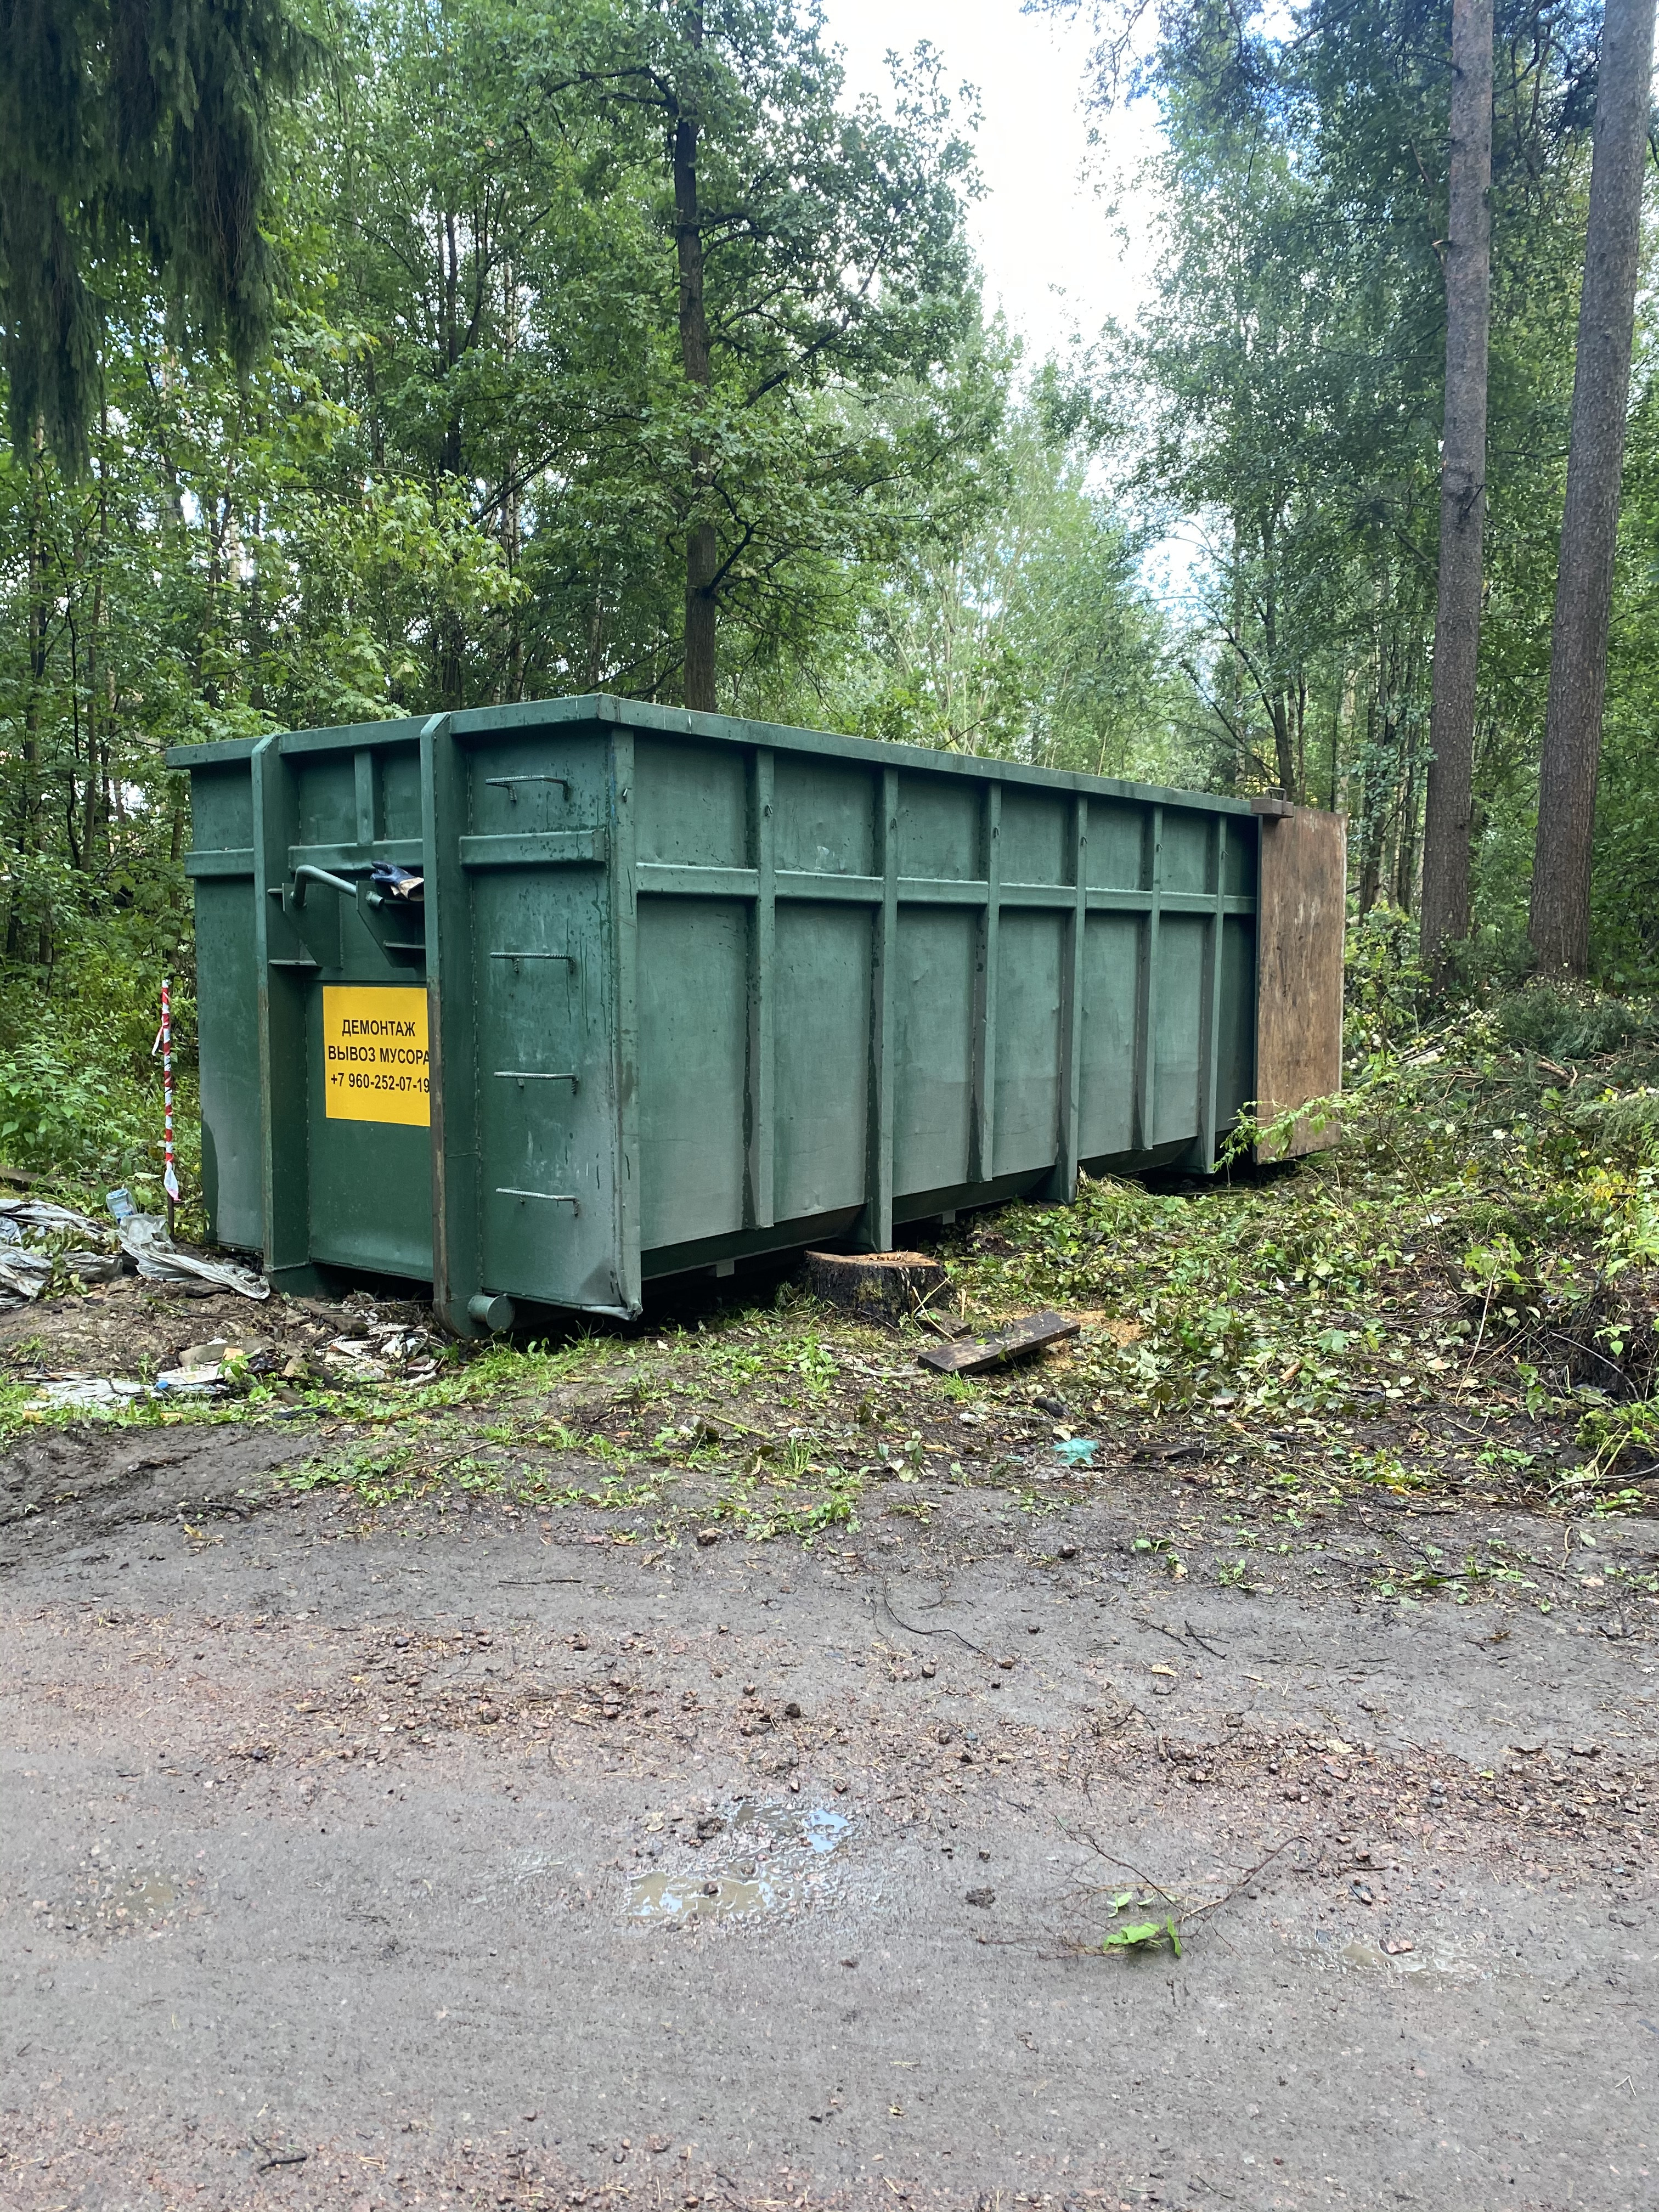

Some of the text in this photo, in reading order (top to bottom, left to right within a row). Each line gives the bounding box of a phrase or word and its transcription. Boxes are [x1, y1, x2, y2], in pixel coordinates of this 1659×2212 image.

[342, 1019, 416, 1037] ДЕМОНТАЖ
[328, 1045, 430, 1065] ВЫВОЗ МУСОРА
[331, 1073, 430, 1093] +7 960-252-07-19
